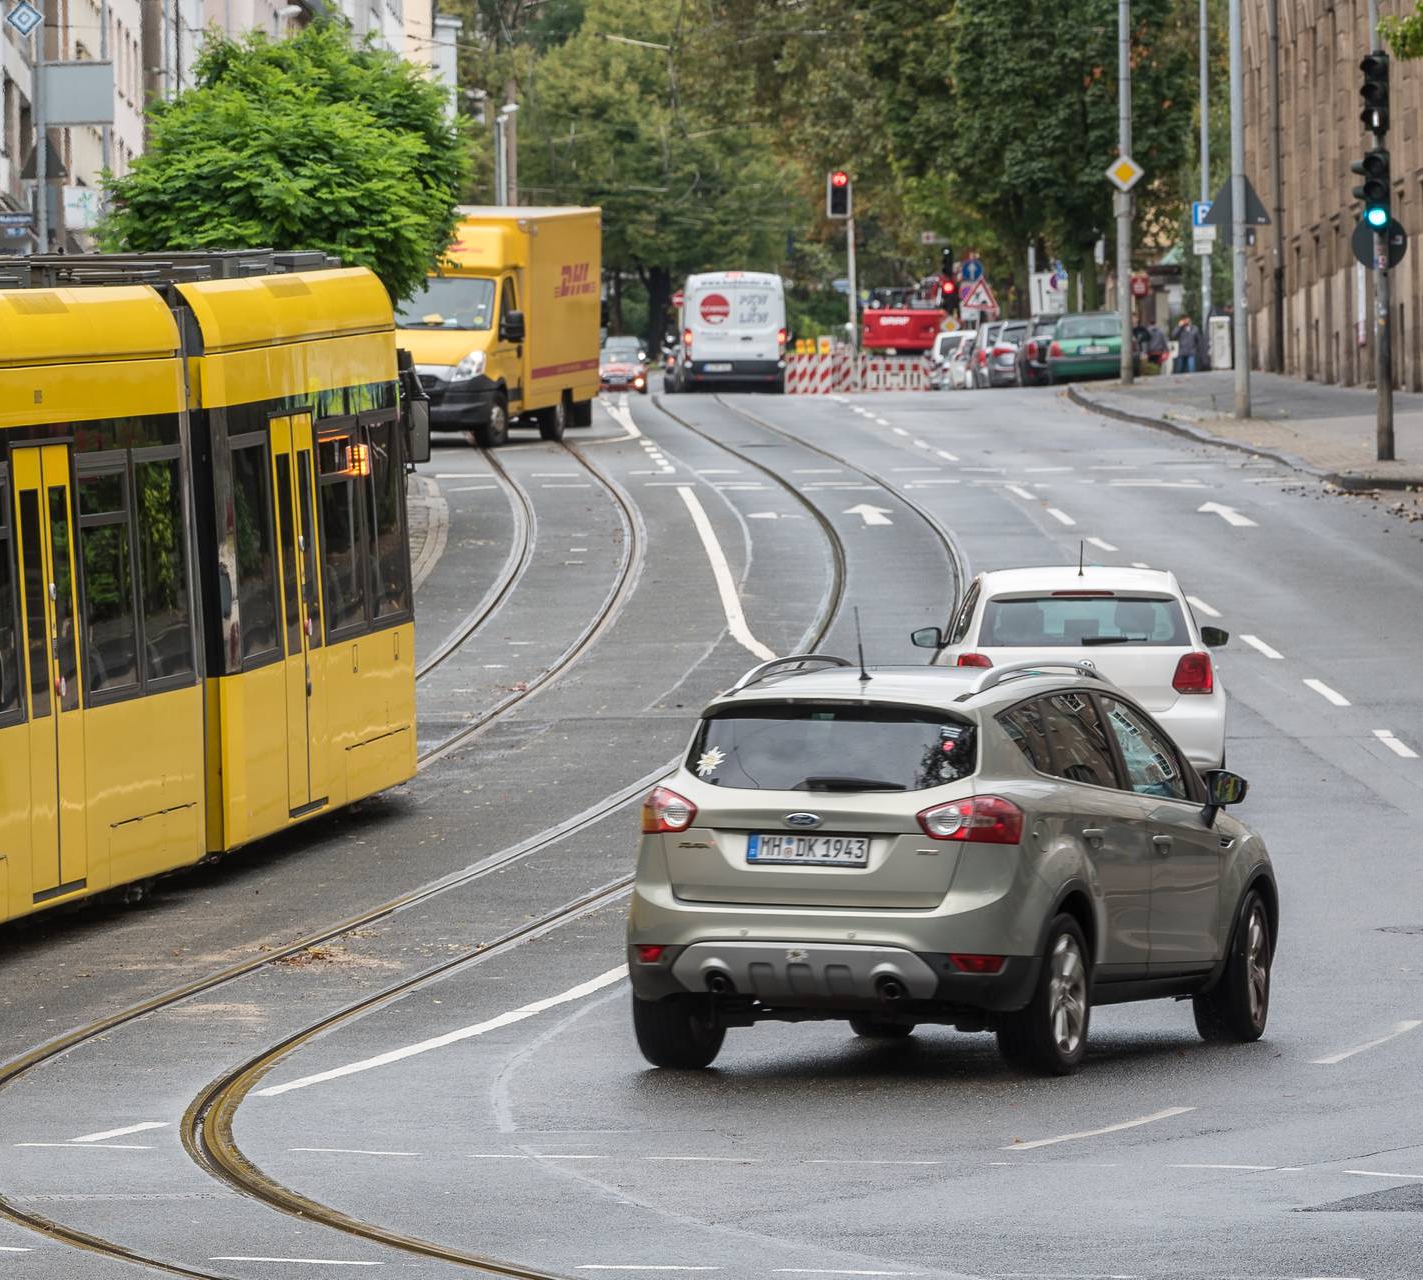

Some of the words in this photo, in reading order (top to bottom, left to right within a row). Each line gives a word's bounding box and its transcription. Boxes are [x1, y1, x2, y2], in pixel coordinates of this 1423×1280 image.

[761, 836, 782, 857] MH
[795, 838, 818, 858] DK
[820, 838, 865, 860] 1943
